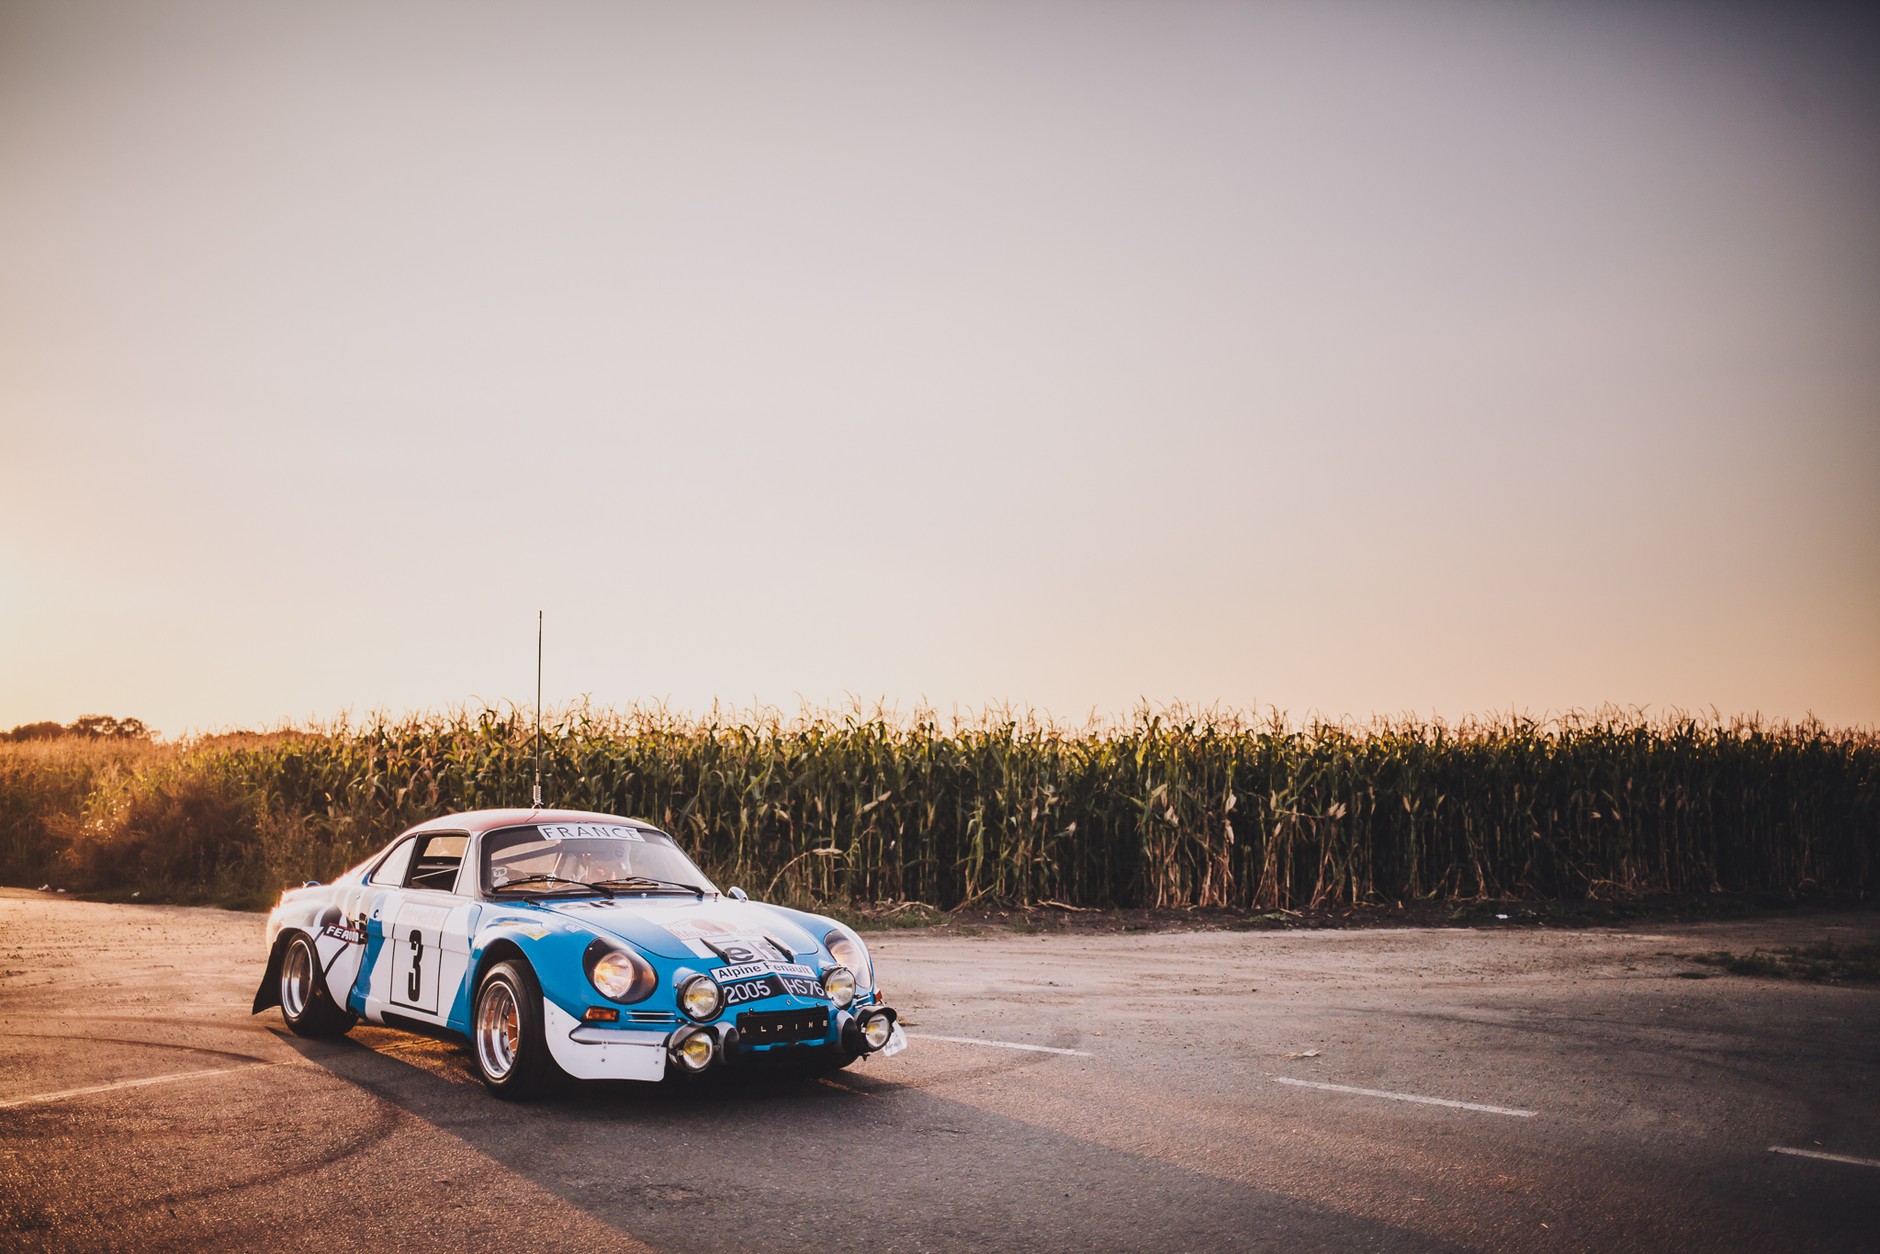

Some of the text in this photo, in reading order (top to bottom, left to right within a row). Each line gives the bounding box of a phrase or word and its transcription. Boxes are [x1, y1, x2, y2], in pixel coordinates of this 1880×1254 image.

[543, 826, 640, 840] FRANCE
[408, 929, 423, 1002] 3
[718, 965, 761, 979] Alpine
[724, 981, 771, 1004] 2005
